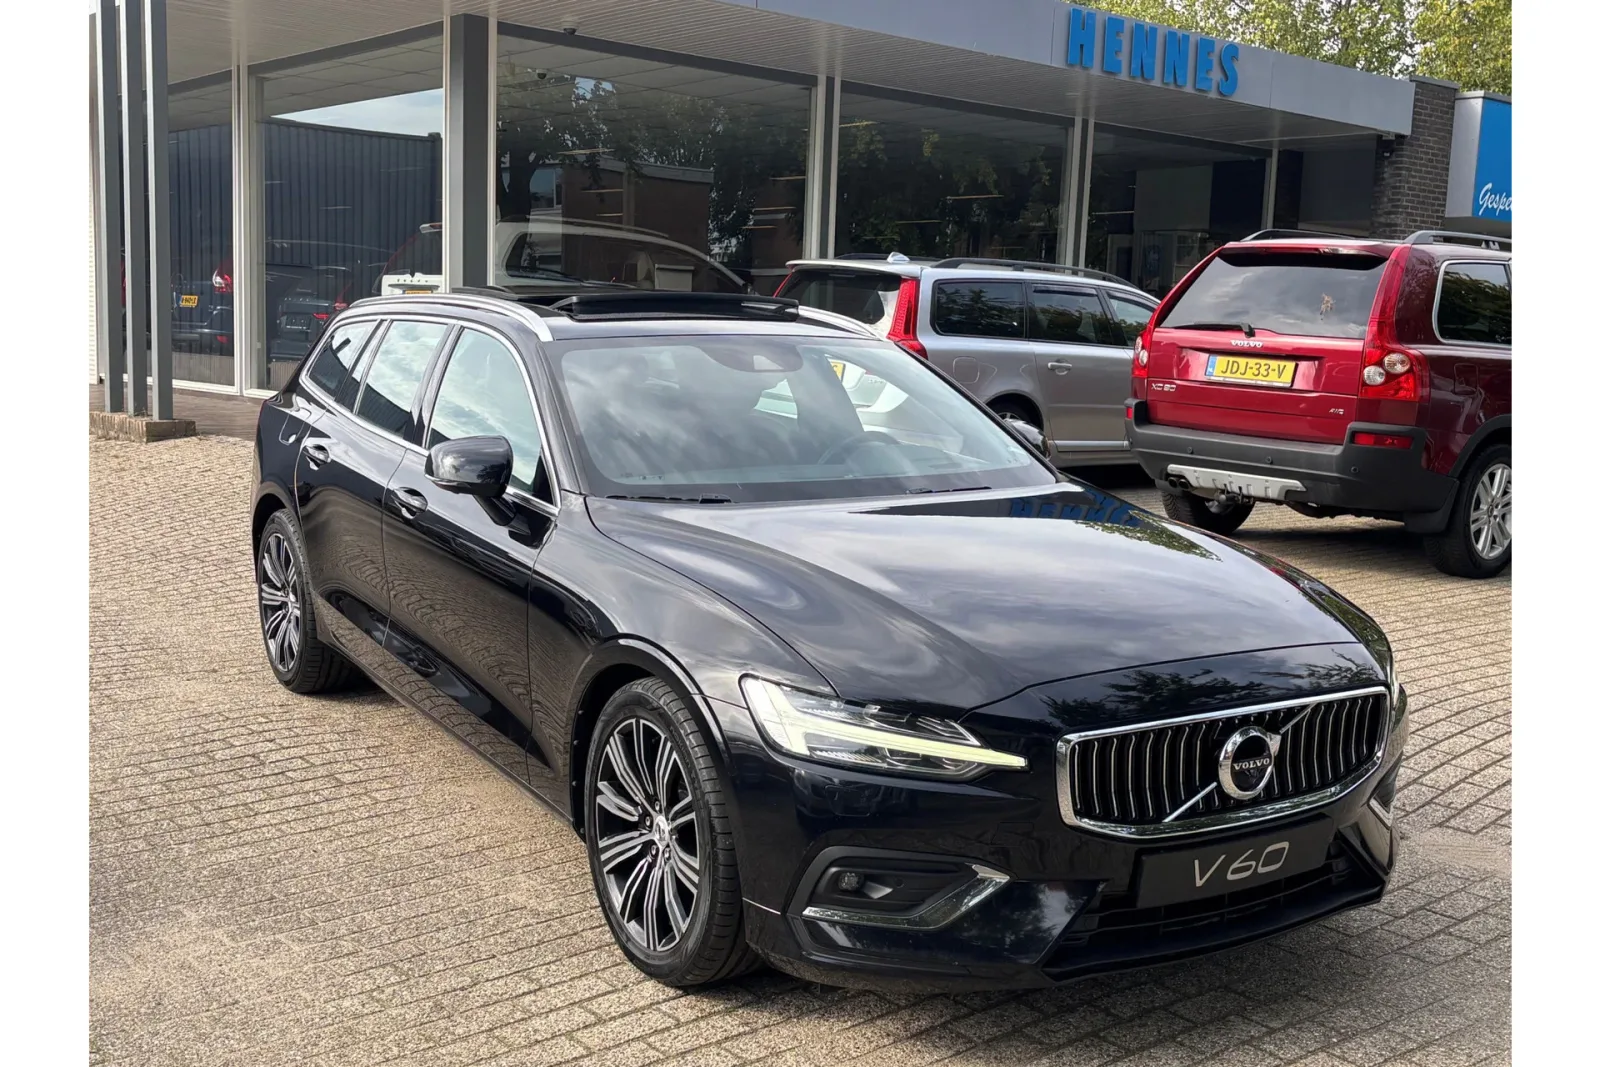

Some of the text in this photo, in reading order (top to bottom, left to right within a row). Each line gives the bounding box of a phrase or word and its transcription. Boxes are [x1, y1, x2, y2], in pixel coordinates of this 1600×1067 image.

[1068, 7, 1239, 97] HENNES
[1478, 182, 1512, 217] Gespe
[1230, 339, 1264, 348] VOLVO
[1221, 359, 1287, 379] JDJ-33-V
[1233, 757, 1270, 771] VOLVO
